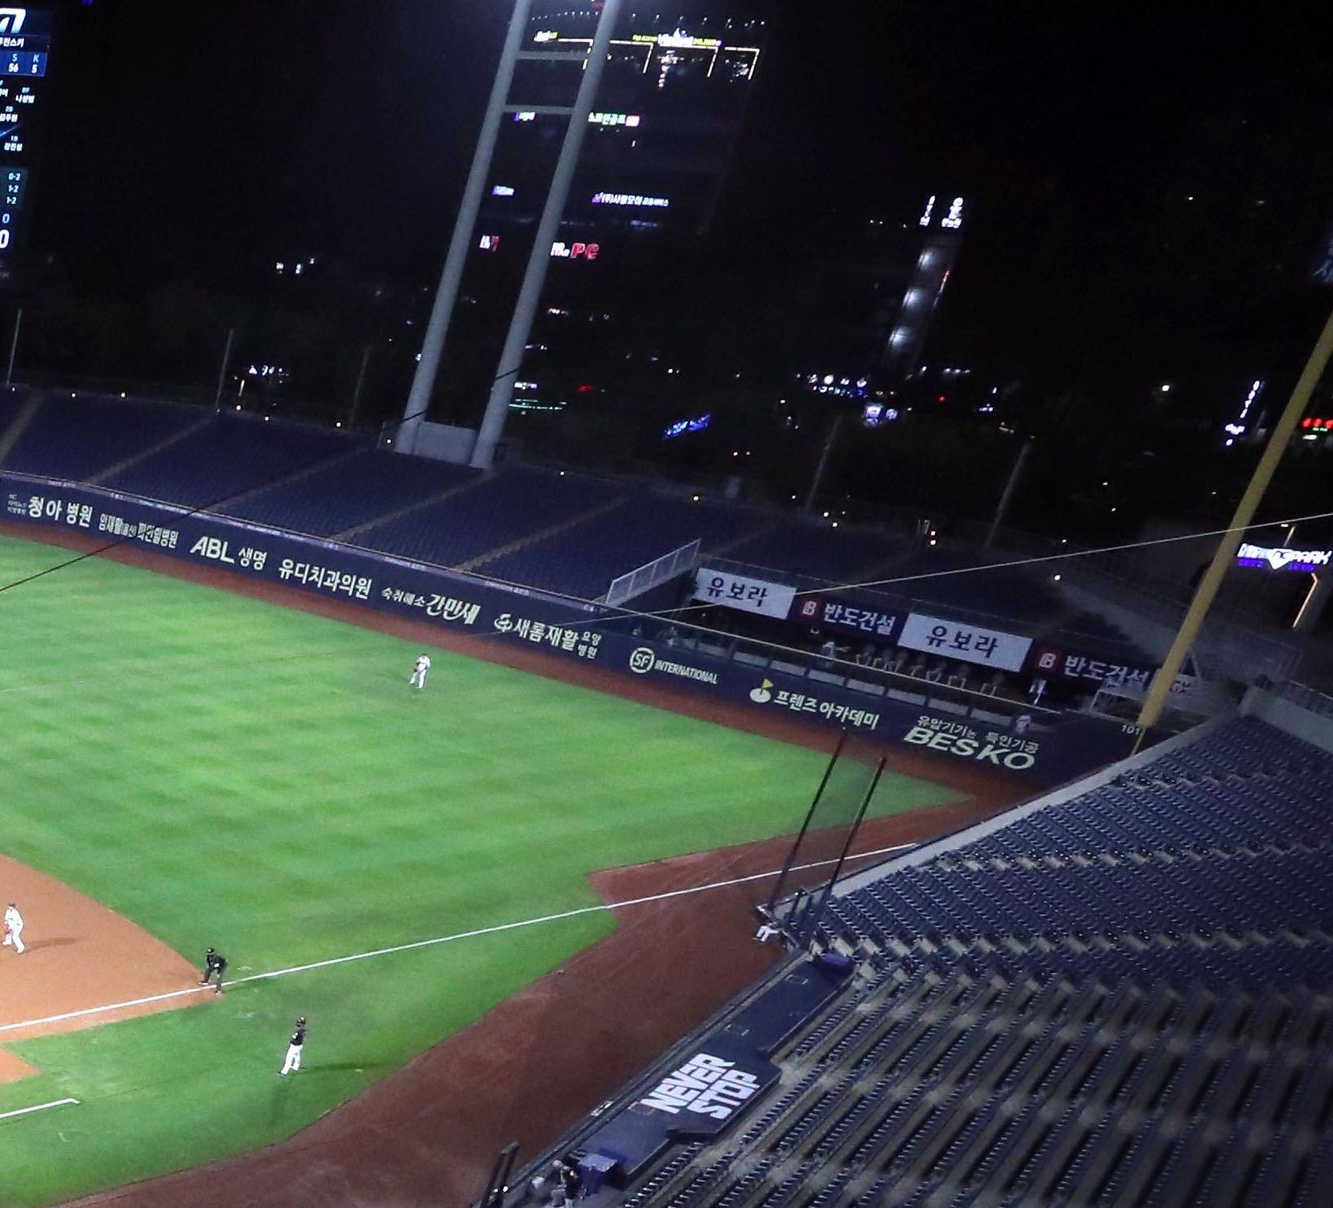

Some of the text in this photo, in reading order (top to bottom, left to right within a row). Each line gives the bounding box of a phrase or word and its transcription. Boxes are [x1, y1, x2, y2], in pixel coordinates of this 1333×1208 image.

[190, 536, 267, 571] ABL 생명
[279, 558, 372, 600] 유디치과의원
[705, 576, 769, 607] 유보라
[382, 587, 481, 625] 숙취해소 간만세
[824, 604, 896, 636] 반도건설
[513, 617, 579, 652] 새롬재활
[581, 631, 602, 646] 요양
[926, 625, 1000, 658] 유보라
[578, 645, 598, 660] 병원
[654, 659, 719, 685] INTERNATIONAL
[773, 690, 880, 730] 프렌즈 아카데미
[917, 715, 977, 739] 유압기기는
[1121, 724, 1140, 736] 101
[903, 726, 1035, 770] BESKO
[640, 1053, 736, 1115] NEVER
[687, 1069, 761, 1120] STOP
